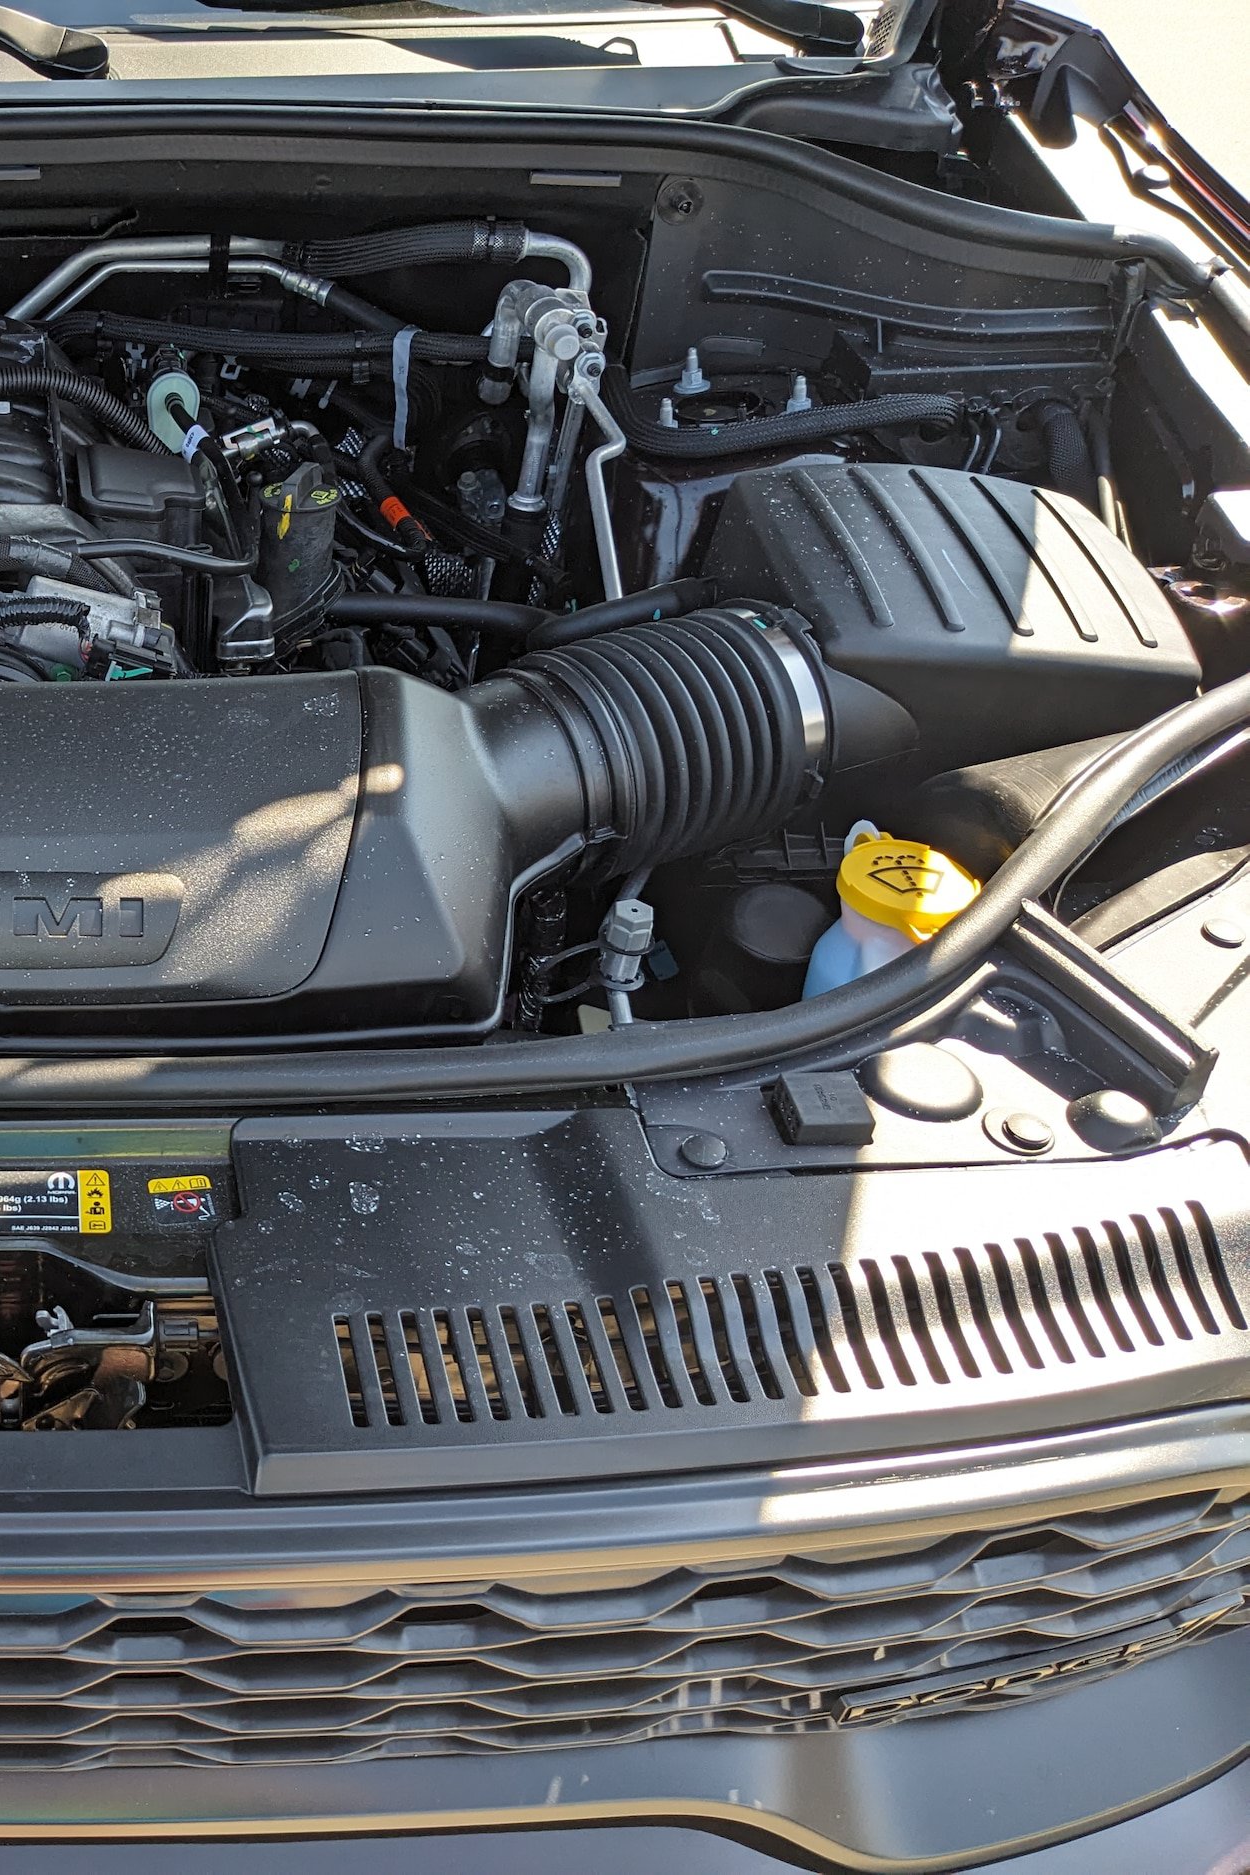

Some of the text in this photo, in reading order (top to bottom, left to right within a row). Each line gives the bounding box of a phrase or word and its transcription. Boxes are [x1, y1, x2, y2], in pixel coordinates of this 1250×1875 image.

[23, 1195, 47, 1204] (2.13
[49, 1195, 68, 1204] lbs)
[3, 1204, 22, 1213] lbs)
